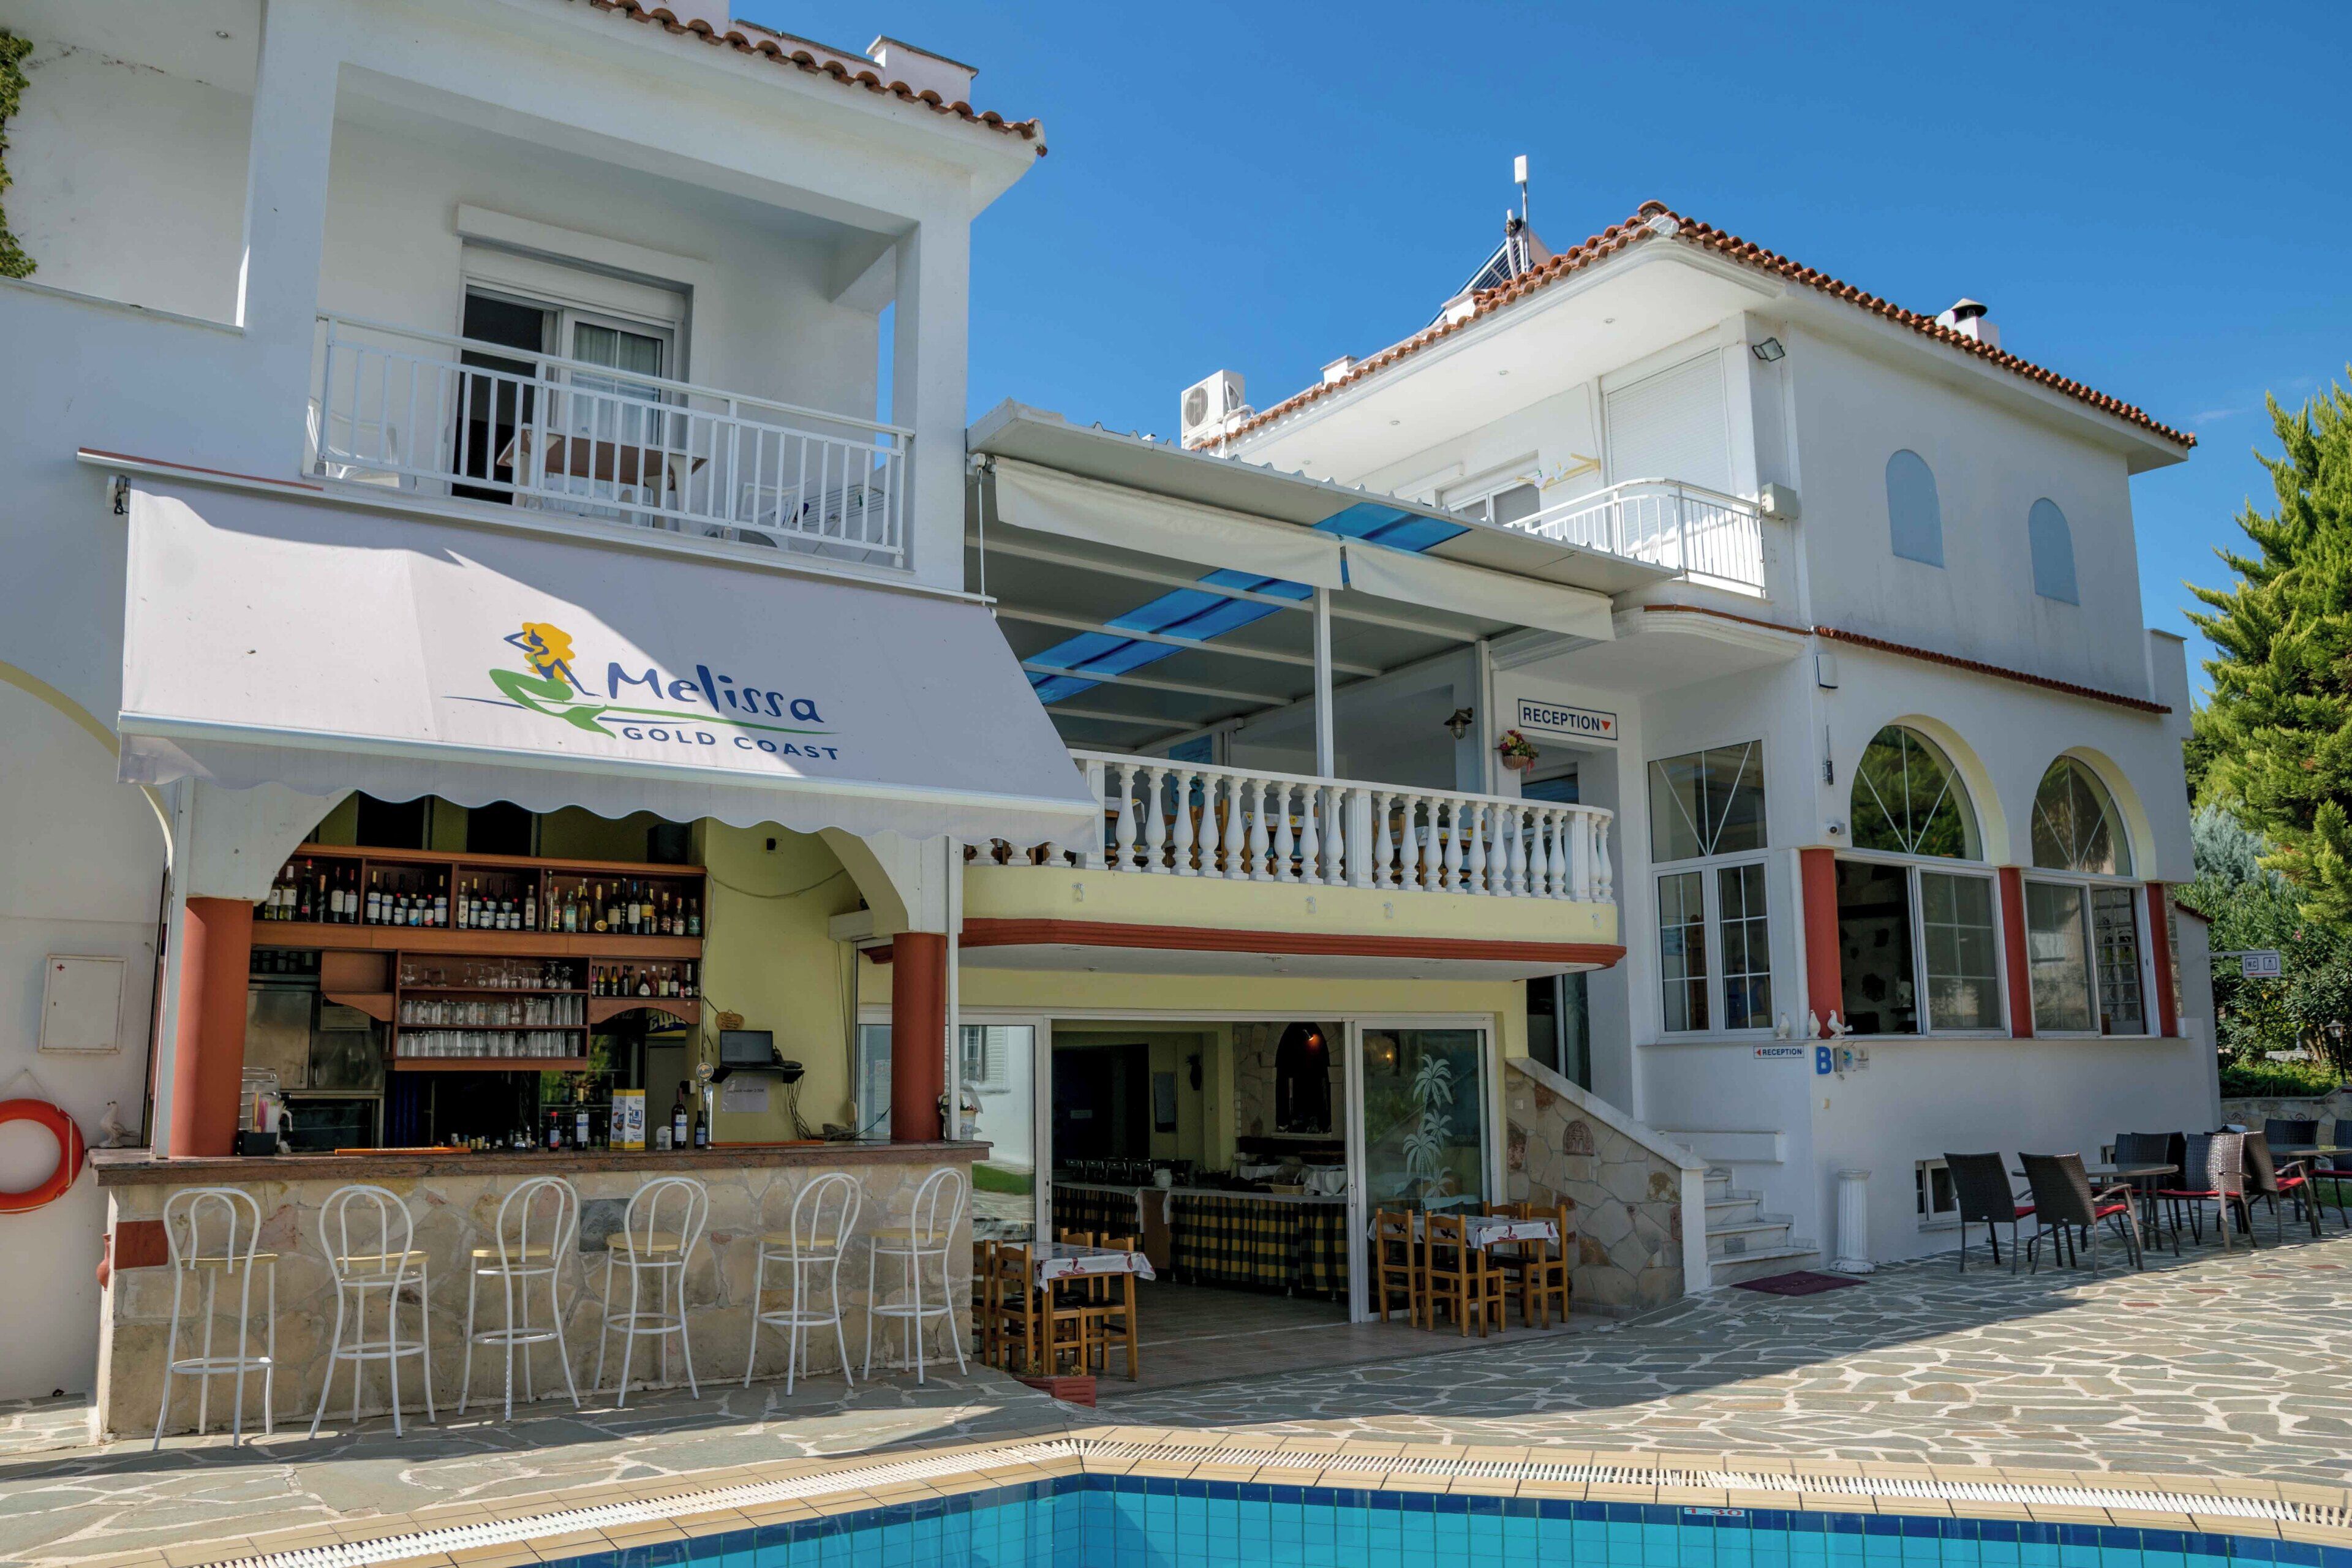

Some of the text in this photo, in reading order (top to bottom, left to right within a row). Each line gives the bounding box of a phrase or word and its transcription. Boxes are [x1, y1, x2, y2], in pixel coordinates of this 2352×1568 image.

[608, 662, 824, 723] Melissa
[1523, 706, 1600, 731] RECEPTION
[623, 727, 839, 761] GOLD COAST
[1762, 1048, 1803, 1057] RECEPTION
[1815, 1046, 1832, 1075] B
